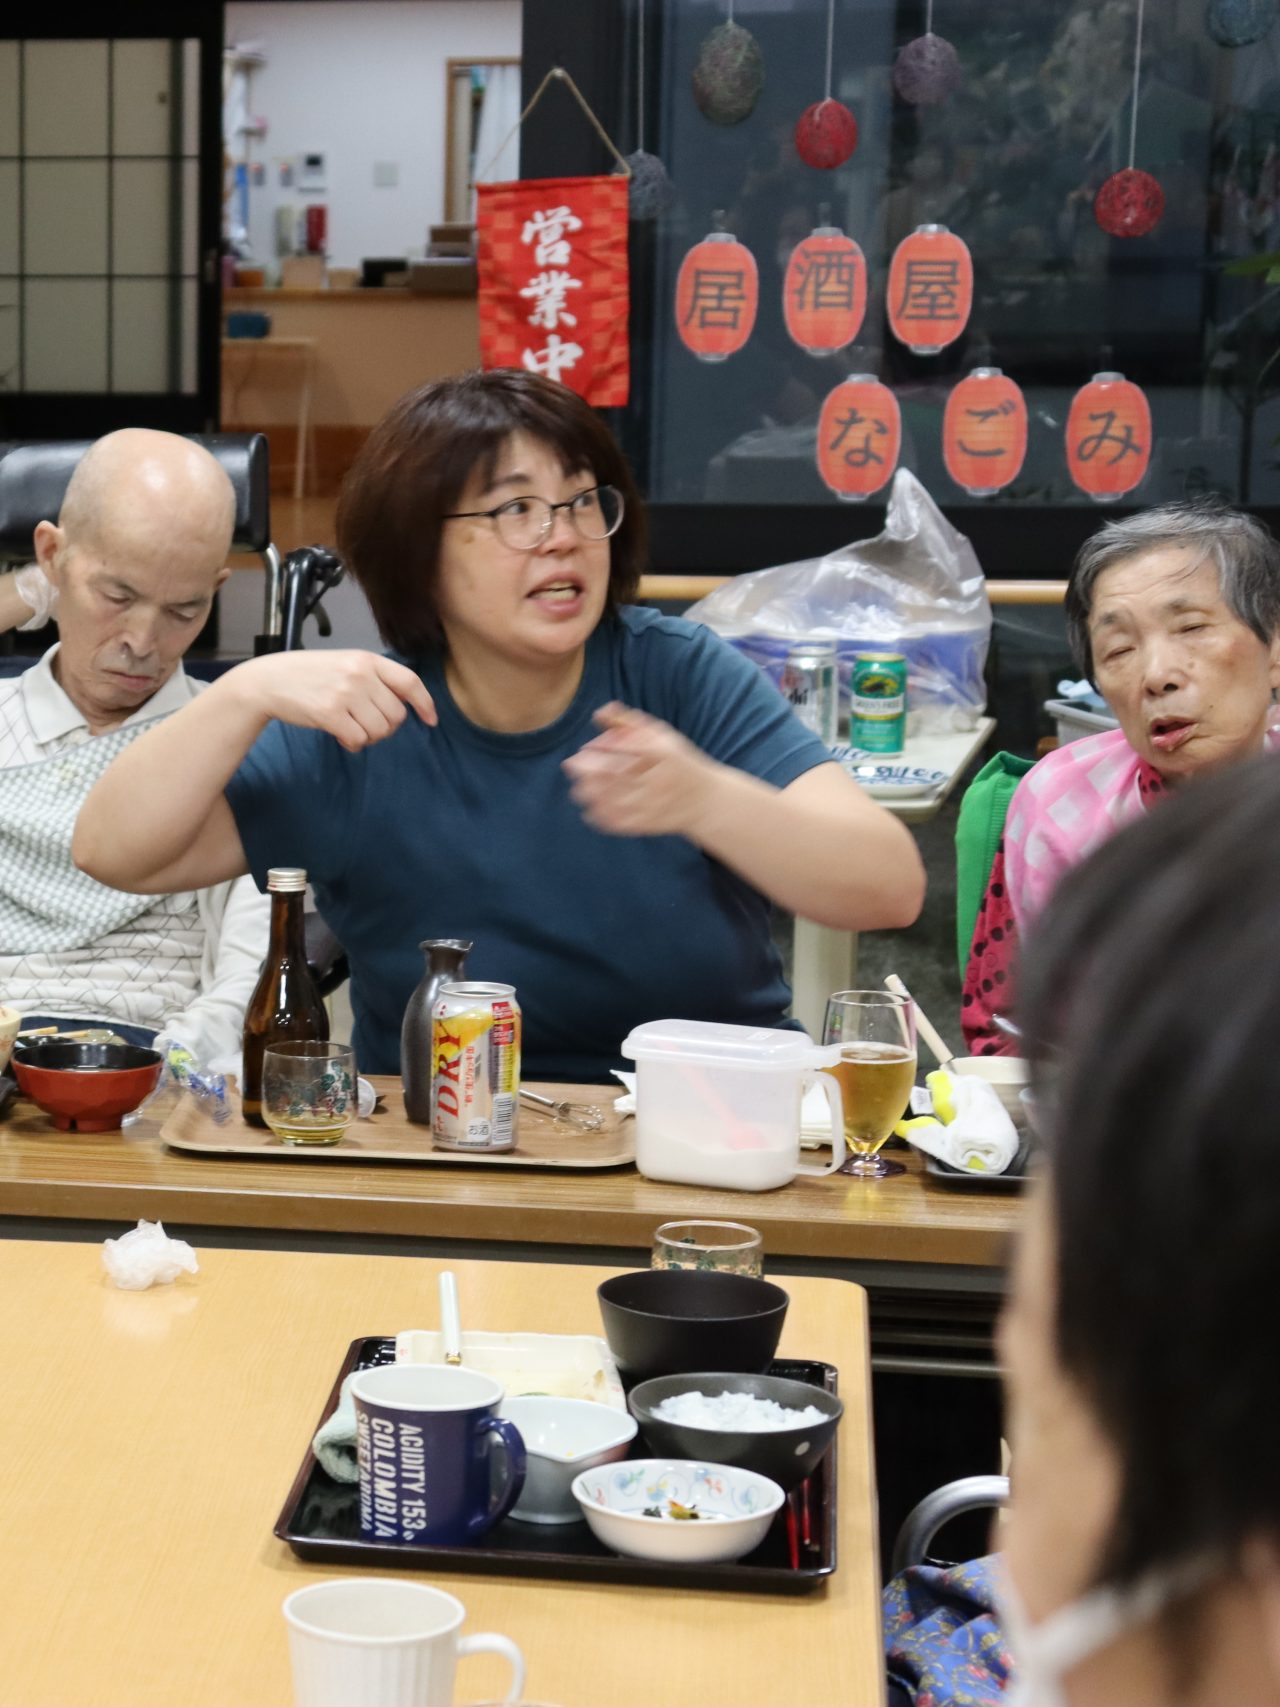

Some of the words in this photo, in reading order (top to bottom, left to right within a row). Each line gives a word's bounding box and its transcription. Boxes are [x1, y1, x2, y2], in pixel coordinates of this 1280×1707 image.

[519, 205, 584, 383] 営業中
[437, 1020, 461, 1119] DRY
[371, 1417, 398, 1537] COLOMBIA
[399, 1423, 425, 1494] ACIDITY
